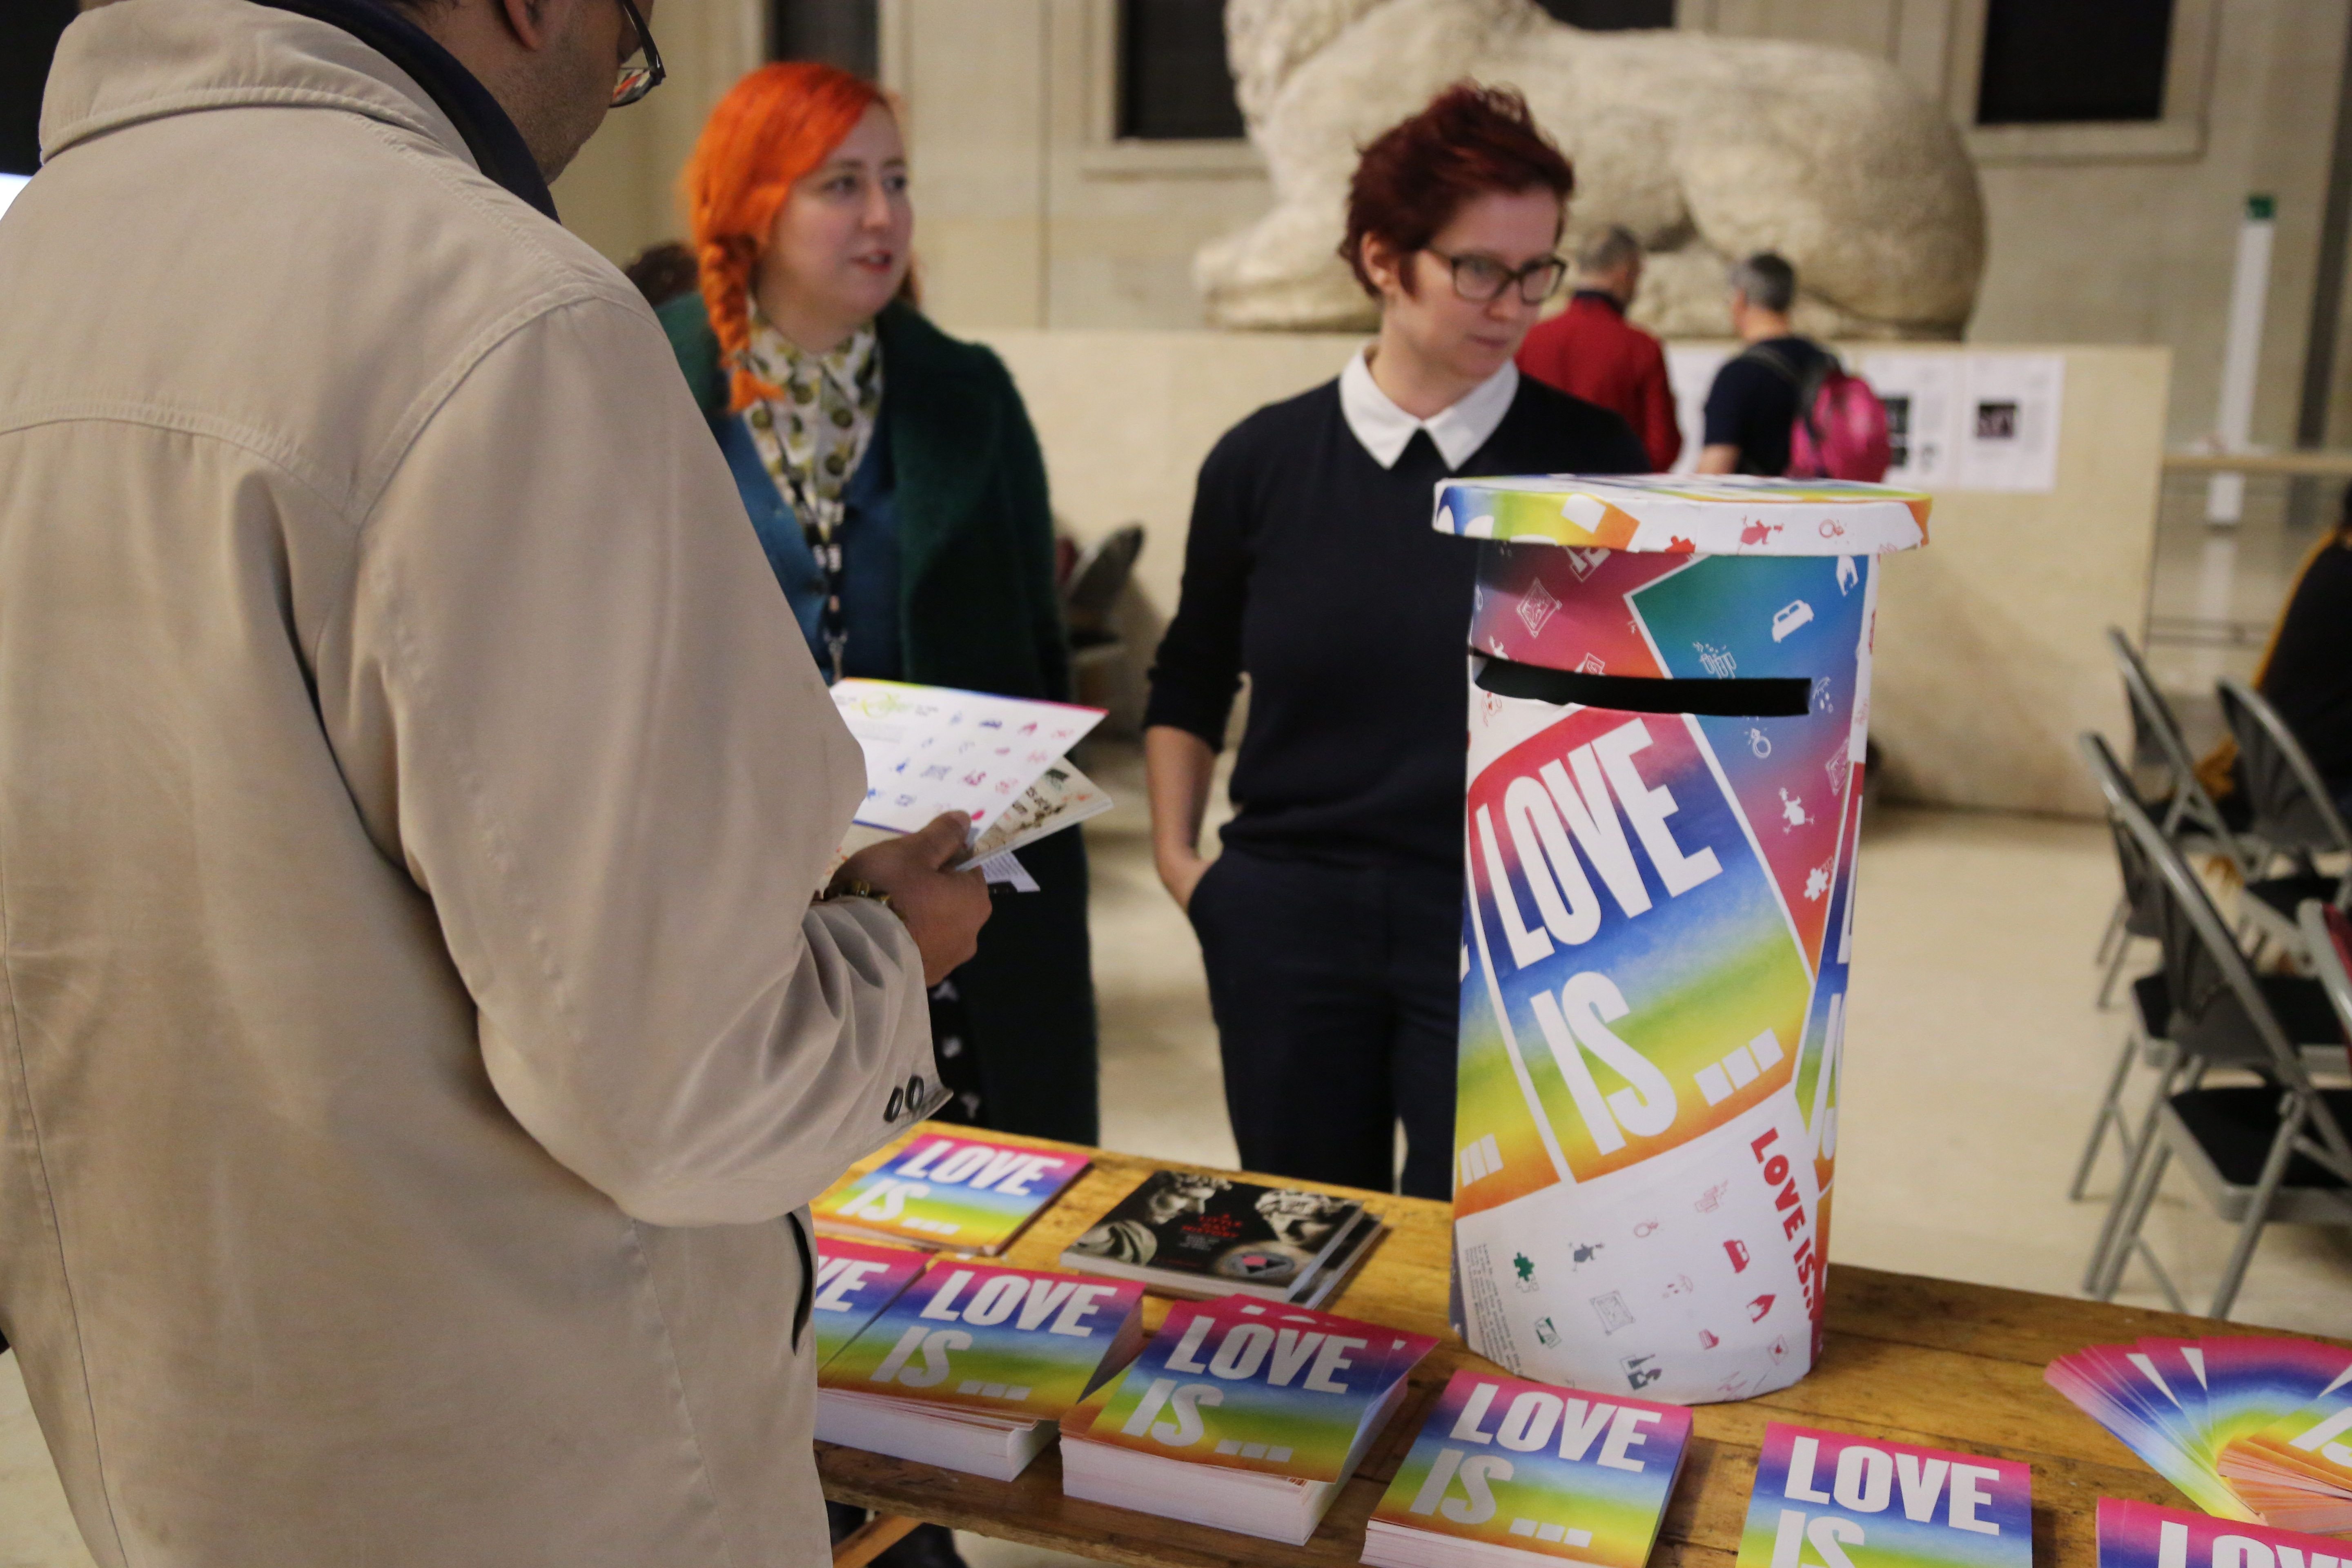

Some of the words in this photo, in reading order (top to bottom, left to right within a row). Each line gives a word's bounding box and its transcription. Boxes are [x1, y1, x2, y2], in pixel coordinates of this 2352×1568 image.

[1477, 718, 1723, 969] LOVE
[894, 1139, 1065, 1196] LOVE
[1751, 1127, 1806, 1242] LOVE
[920, 1270, 1117, 1337] LOVE
[1164, 1315, 1368, 1394] LOVE
[1450, 1383, 1662, 1472] LOVE
[1784, 1435, 2000, 1535] LOVE
